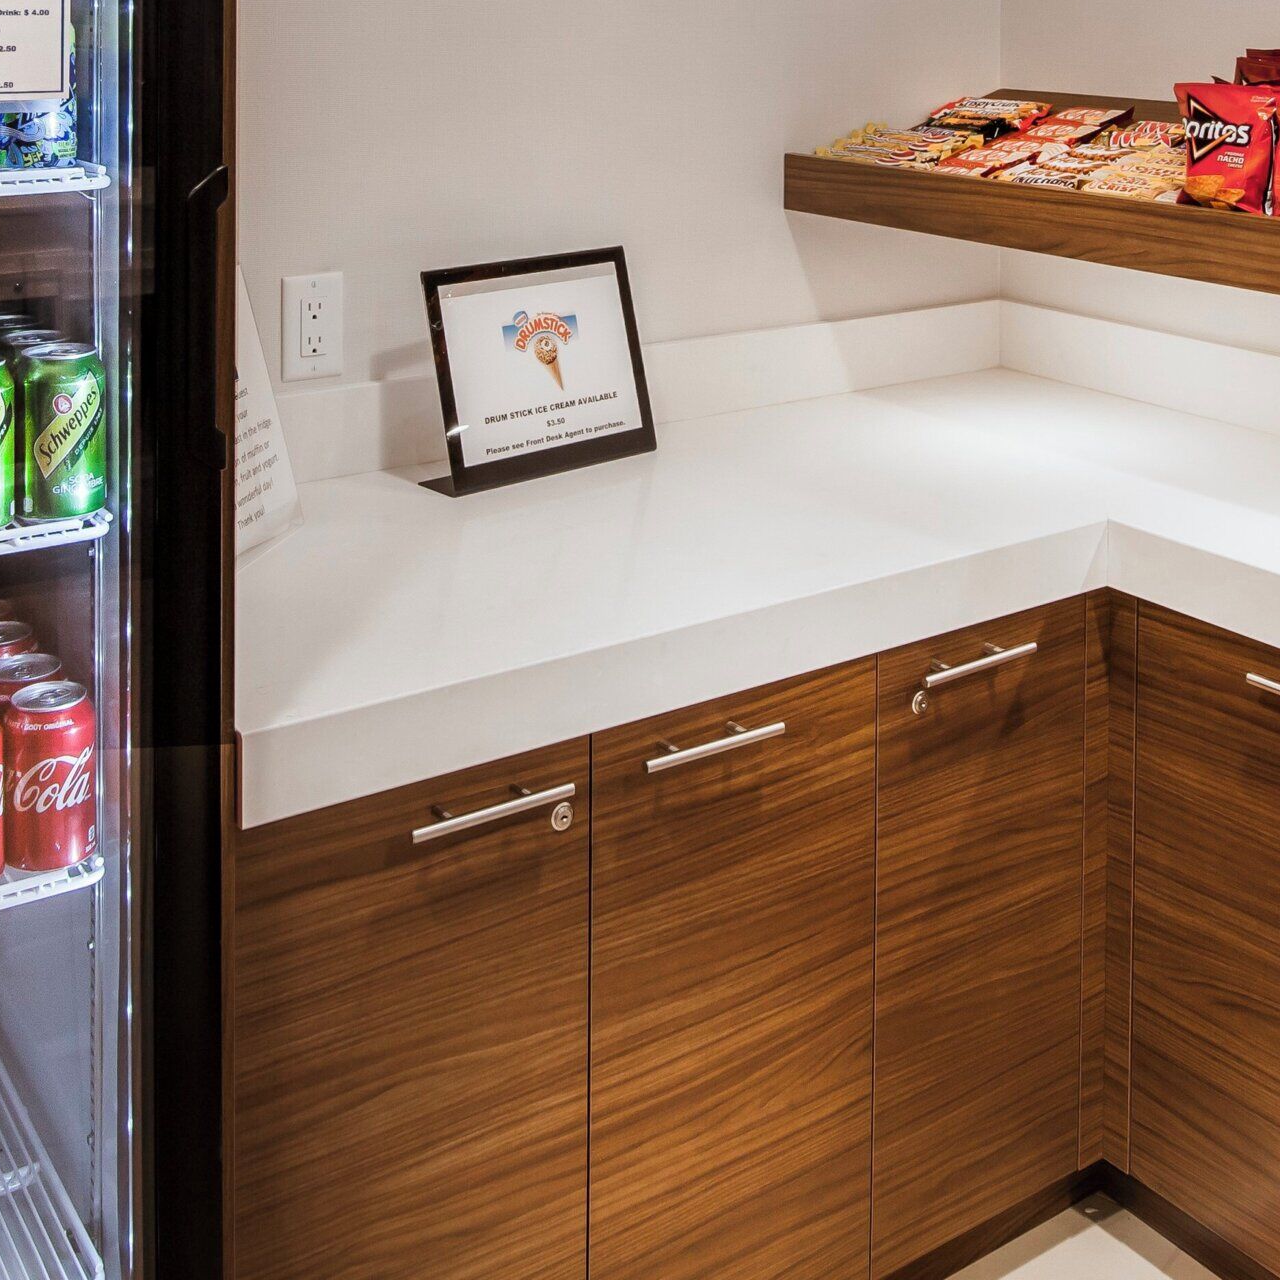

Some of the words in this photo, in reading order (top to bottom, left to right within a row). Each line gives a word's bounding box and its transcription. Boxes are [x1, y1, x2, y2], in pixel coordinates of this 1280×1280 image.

[1216, 155, 1245, 165] NACHO
[514, 315, 573, 352] DRUMSTICK
[236, 409, 248, 423] your
[484, 413, 508, 425] DRUM
[510, 408, 534, 420] STICK
[535, 405, 548, 415] ICE
[549, 400, 576, 412] CREAM
[577, 391, 618, 406] AVAILABLE
[39, 386, 98, 466] Schweppes
[248, 426, 258, 438] the
[257, 417, 272, 432] fridge
[546, 417, 566, 428] $3.50
[486, 445, 510, 456] Please
[511, 442, 524, 450] see
[526, 437, 545, 448] Front
[546, 433, 563, 443] Desk
[564, 428, 584, 440] Agent
[594, 420, 626, 433] purchase.
[246, 444, 264, 461] muffin
[264, 439, 270, 451] or
[239, 469, 253, 484] fruit
[251, 463, 262, 476] and
[236, 484, 263, 509] wonderful
[236, 512, 254, 531] Thank
[253, 504, 266, 521] you!
